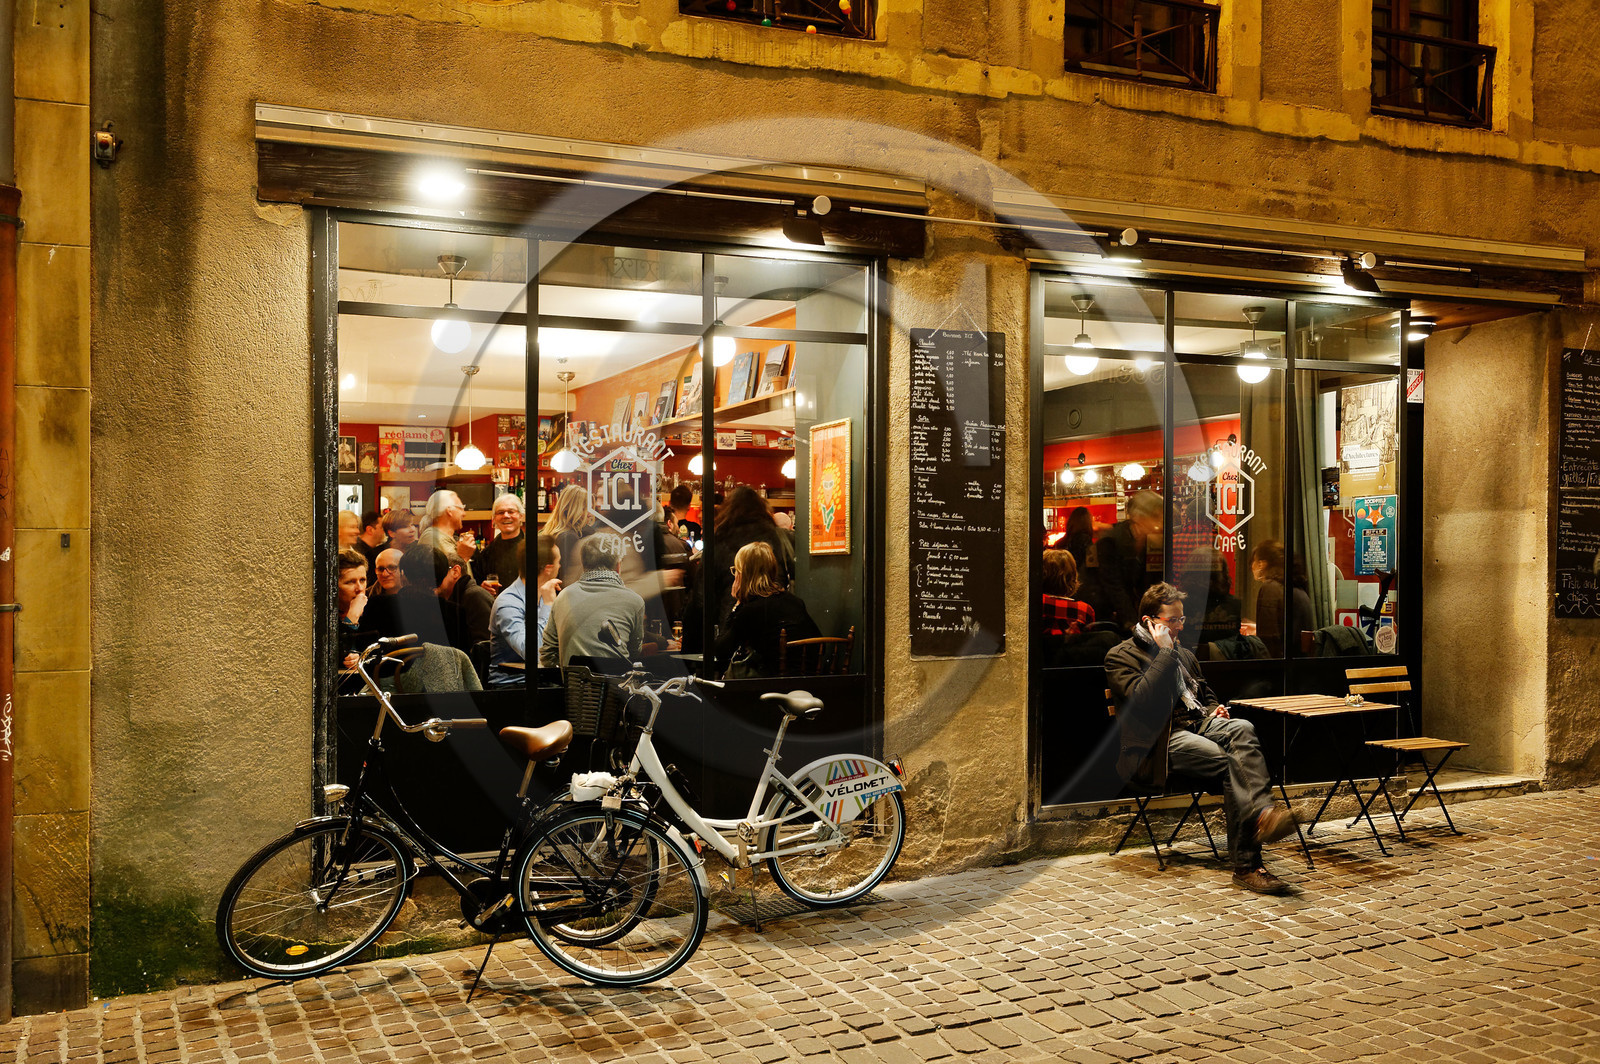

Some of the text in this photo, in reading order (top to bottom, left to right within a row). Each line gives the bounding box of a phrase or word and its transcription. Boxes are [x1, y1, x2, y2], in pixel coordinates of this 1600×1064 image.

[570, 423, 675, 462] RESTAURANT
[611, 458, 634, 471] Chez
[1222, 471, 1240, 482] Chez
[600, 472, 642, 511] ICI
[1215, 483, 1245, 515] ICI
[599, 530, 645, 556] CAFÉ
[1213, 531, 1246, 553] CAFÉ
